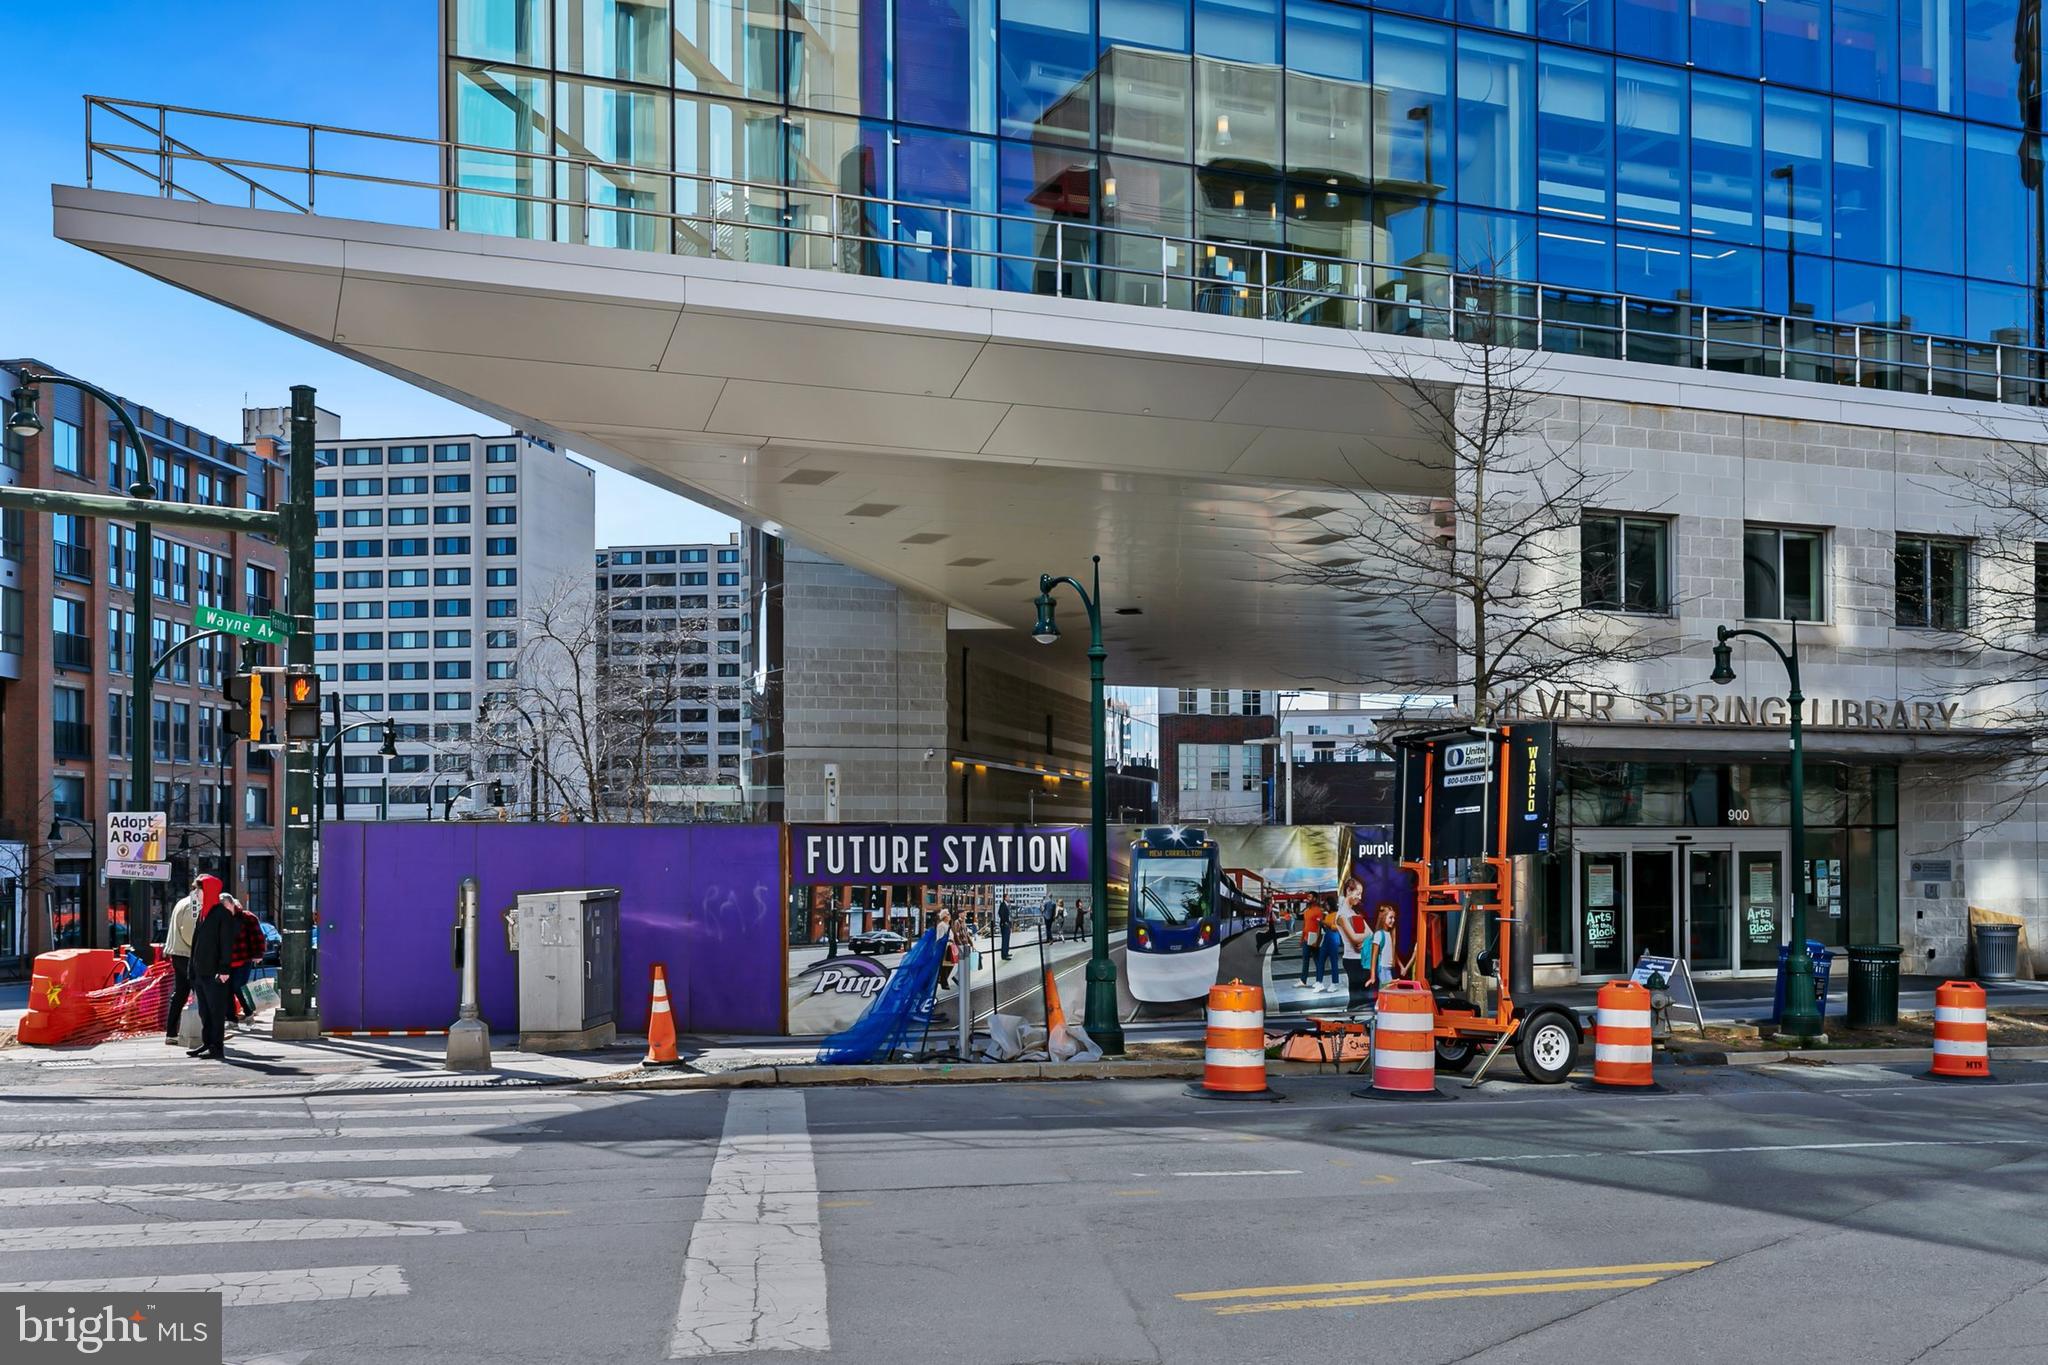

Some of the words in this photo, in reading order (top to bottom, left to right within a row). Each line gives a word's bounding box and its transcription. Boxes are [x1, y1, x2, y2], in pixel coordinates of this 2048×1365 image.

[206, 610, 251, 633] Wayne
[257, 623, 274, 638] Av
[1643, 692, 1787, 728] SPRING
[1811, 698, 1960, 731] LIBRARY
[1527, 745, 1539, 812] WANCO
[1727, 808, 1750, 821] 900
[110, 815, 154, 831] Adopt
[110, 830, 121, 843] A
[123, 830, 159, 843] Road
[806, 835, 929, 874] FUTURE
[942, 835, 1067, 873] STATION
[1358, 841, 1394, 859] purple
[1586, 911, 1612, 926] Arts
[1747, 907, 1771, 921] Arts
[1588, 927, 1616, 941] Block
[1749, 921, 1775, 935] Block
